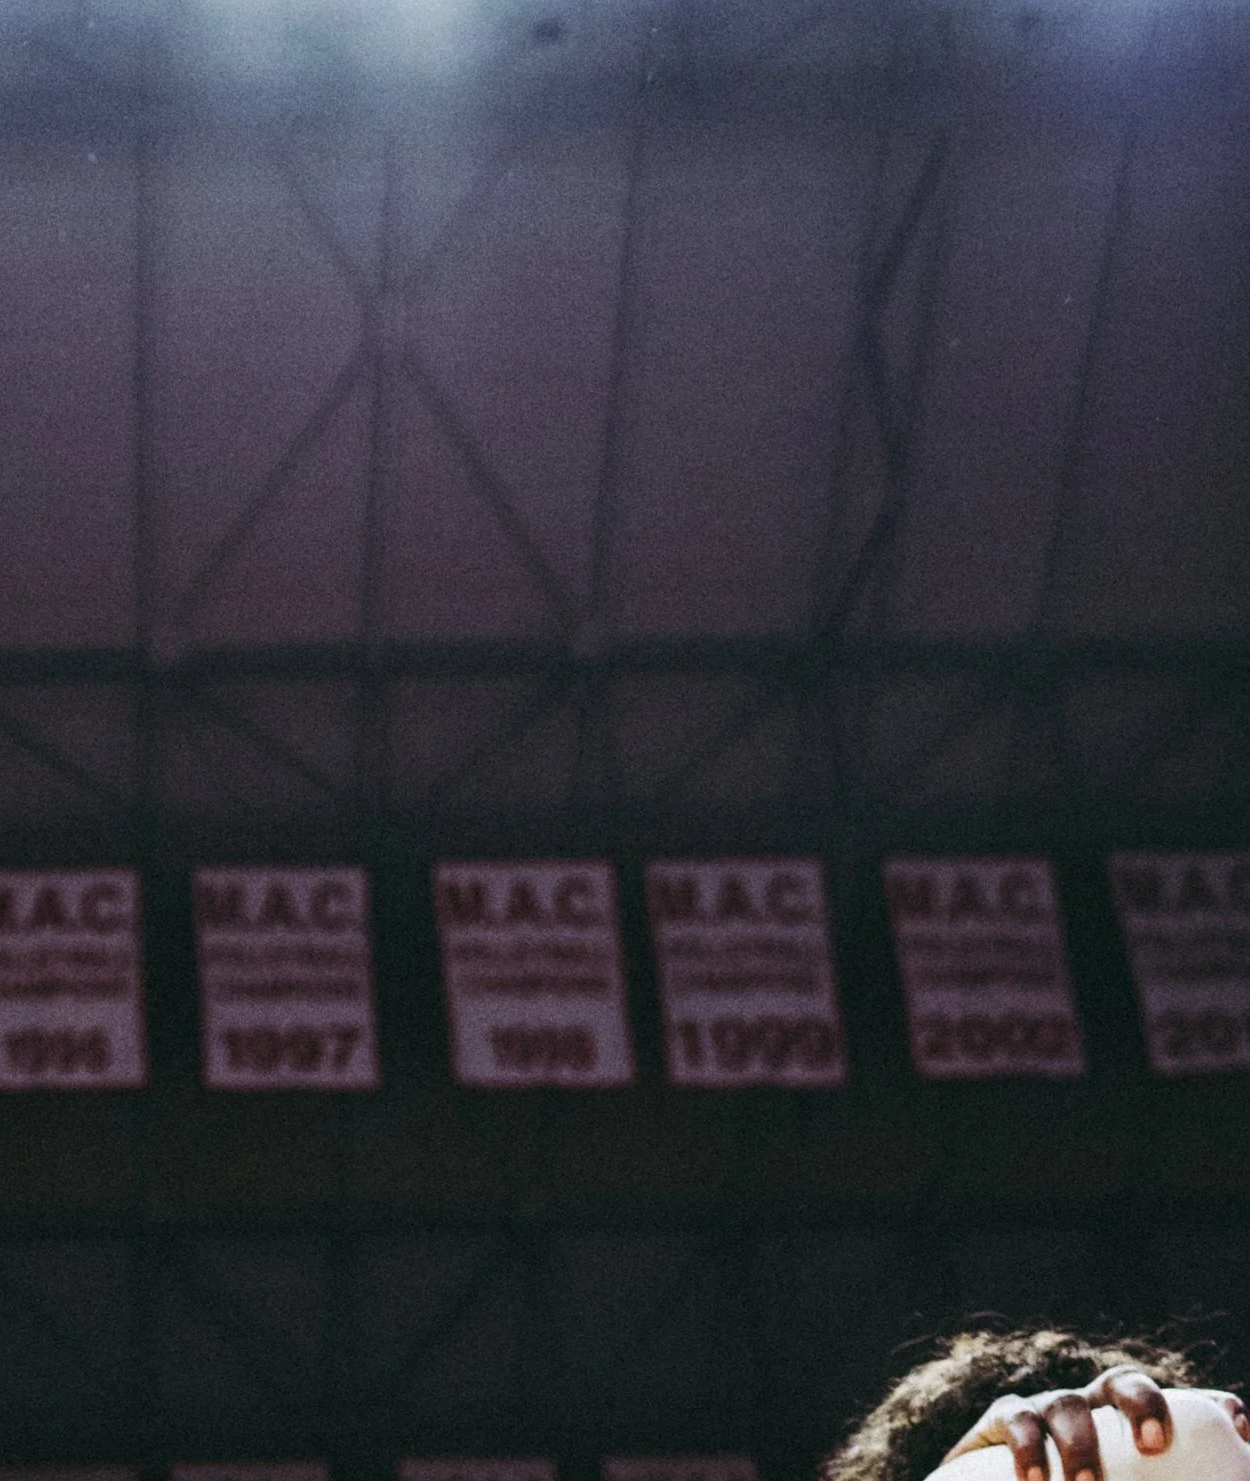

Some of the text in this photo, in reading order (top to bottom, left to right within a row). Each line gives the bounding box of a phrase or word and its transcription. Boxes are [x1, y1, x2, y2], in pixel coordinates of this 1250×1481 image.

[223, 1026, 361, 1072] 1997
[679, 1018, 840, 1070] 1999
[1158, 1009, 1250, 1056] 20
